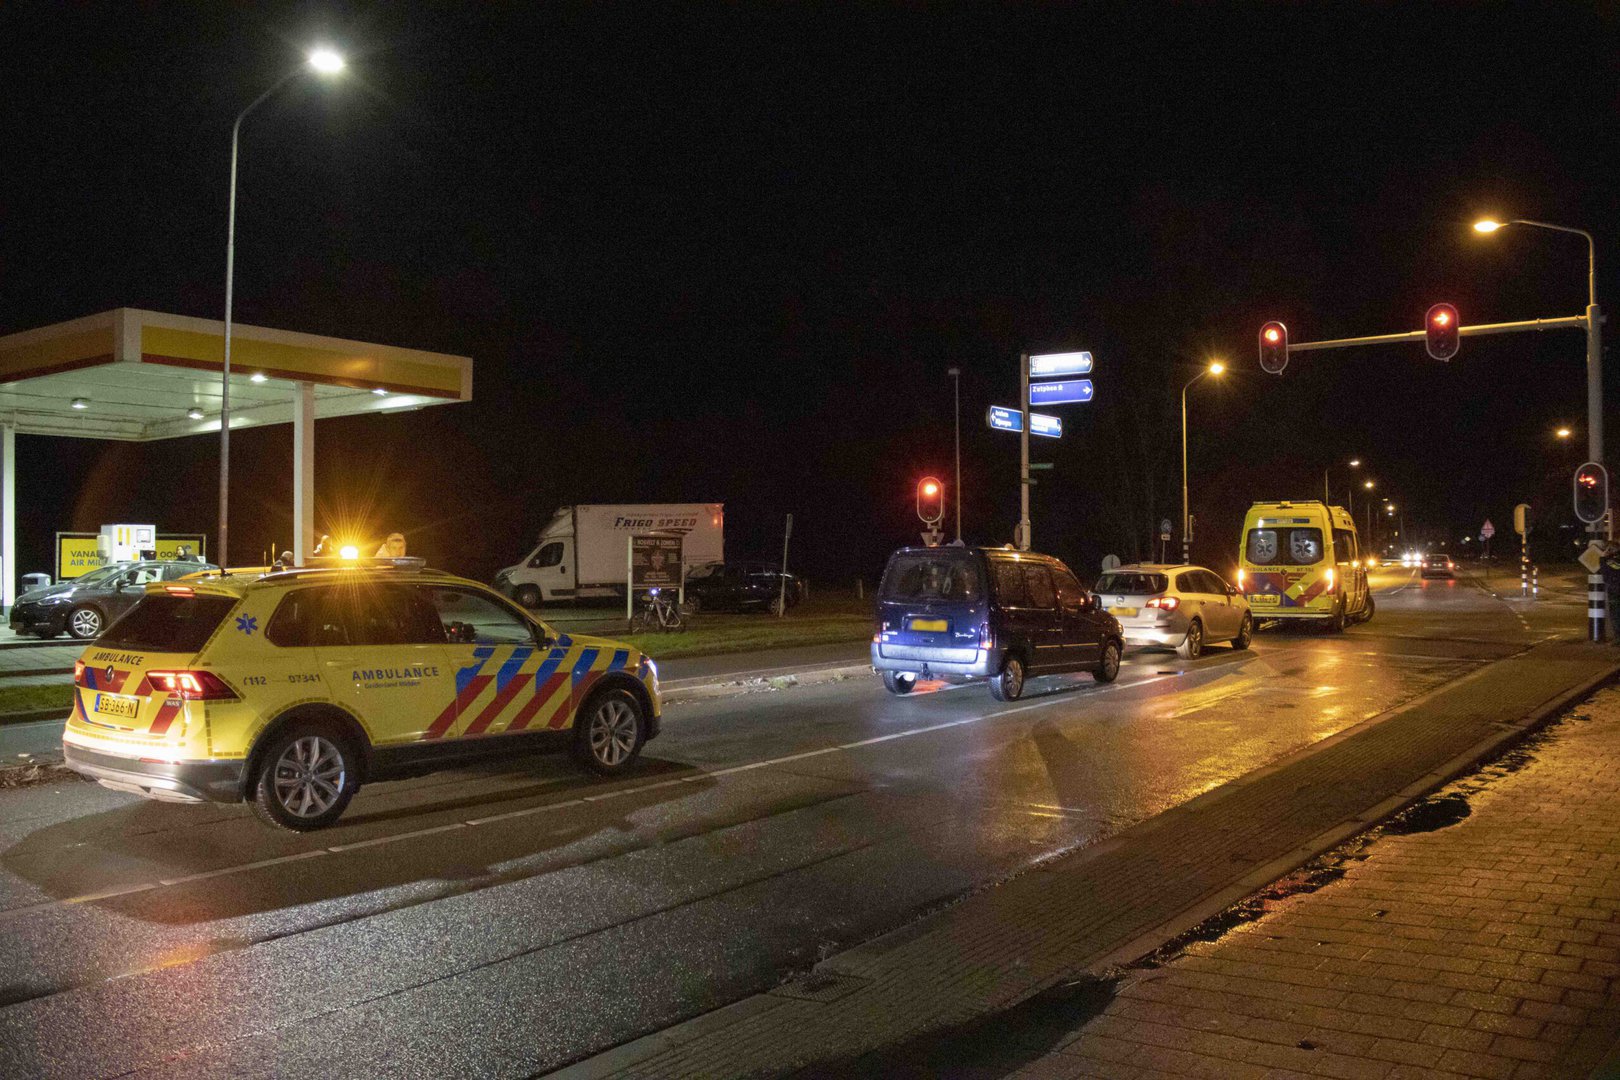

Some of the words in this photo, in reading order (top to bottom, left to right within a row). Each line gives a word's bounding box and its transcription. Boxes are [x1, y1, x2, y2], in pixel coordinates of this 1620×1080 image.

[657, 518, 697, 527] SPEED
[93, 652, 144, 666] AMBULANCE
[288, 673, 321, 684] 07341
[352, 666, 439, 681] AMBULANCE
[99, 697, 135, 716] SB-366-N
